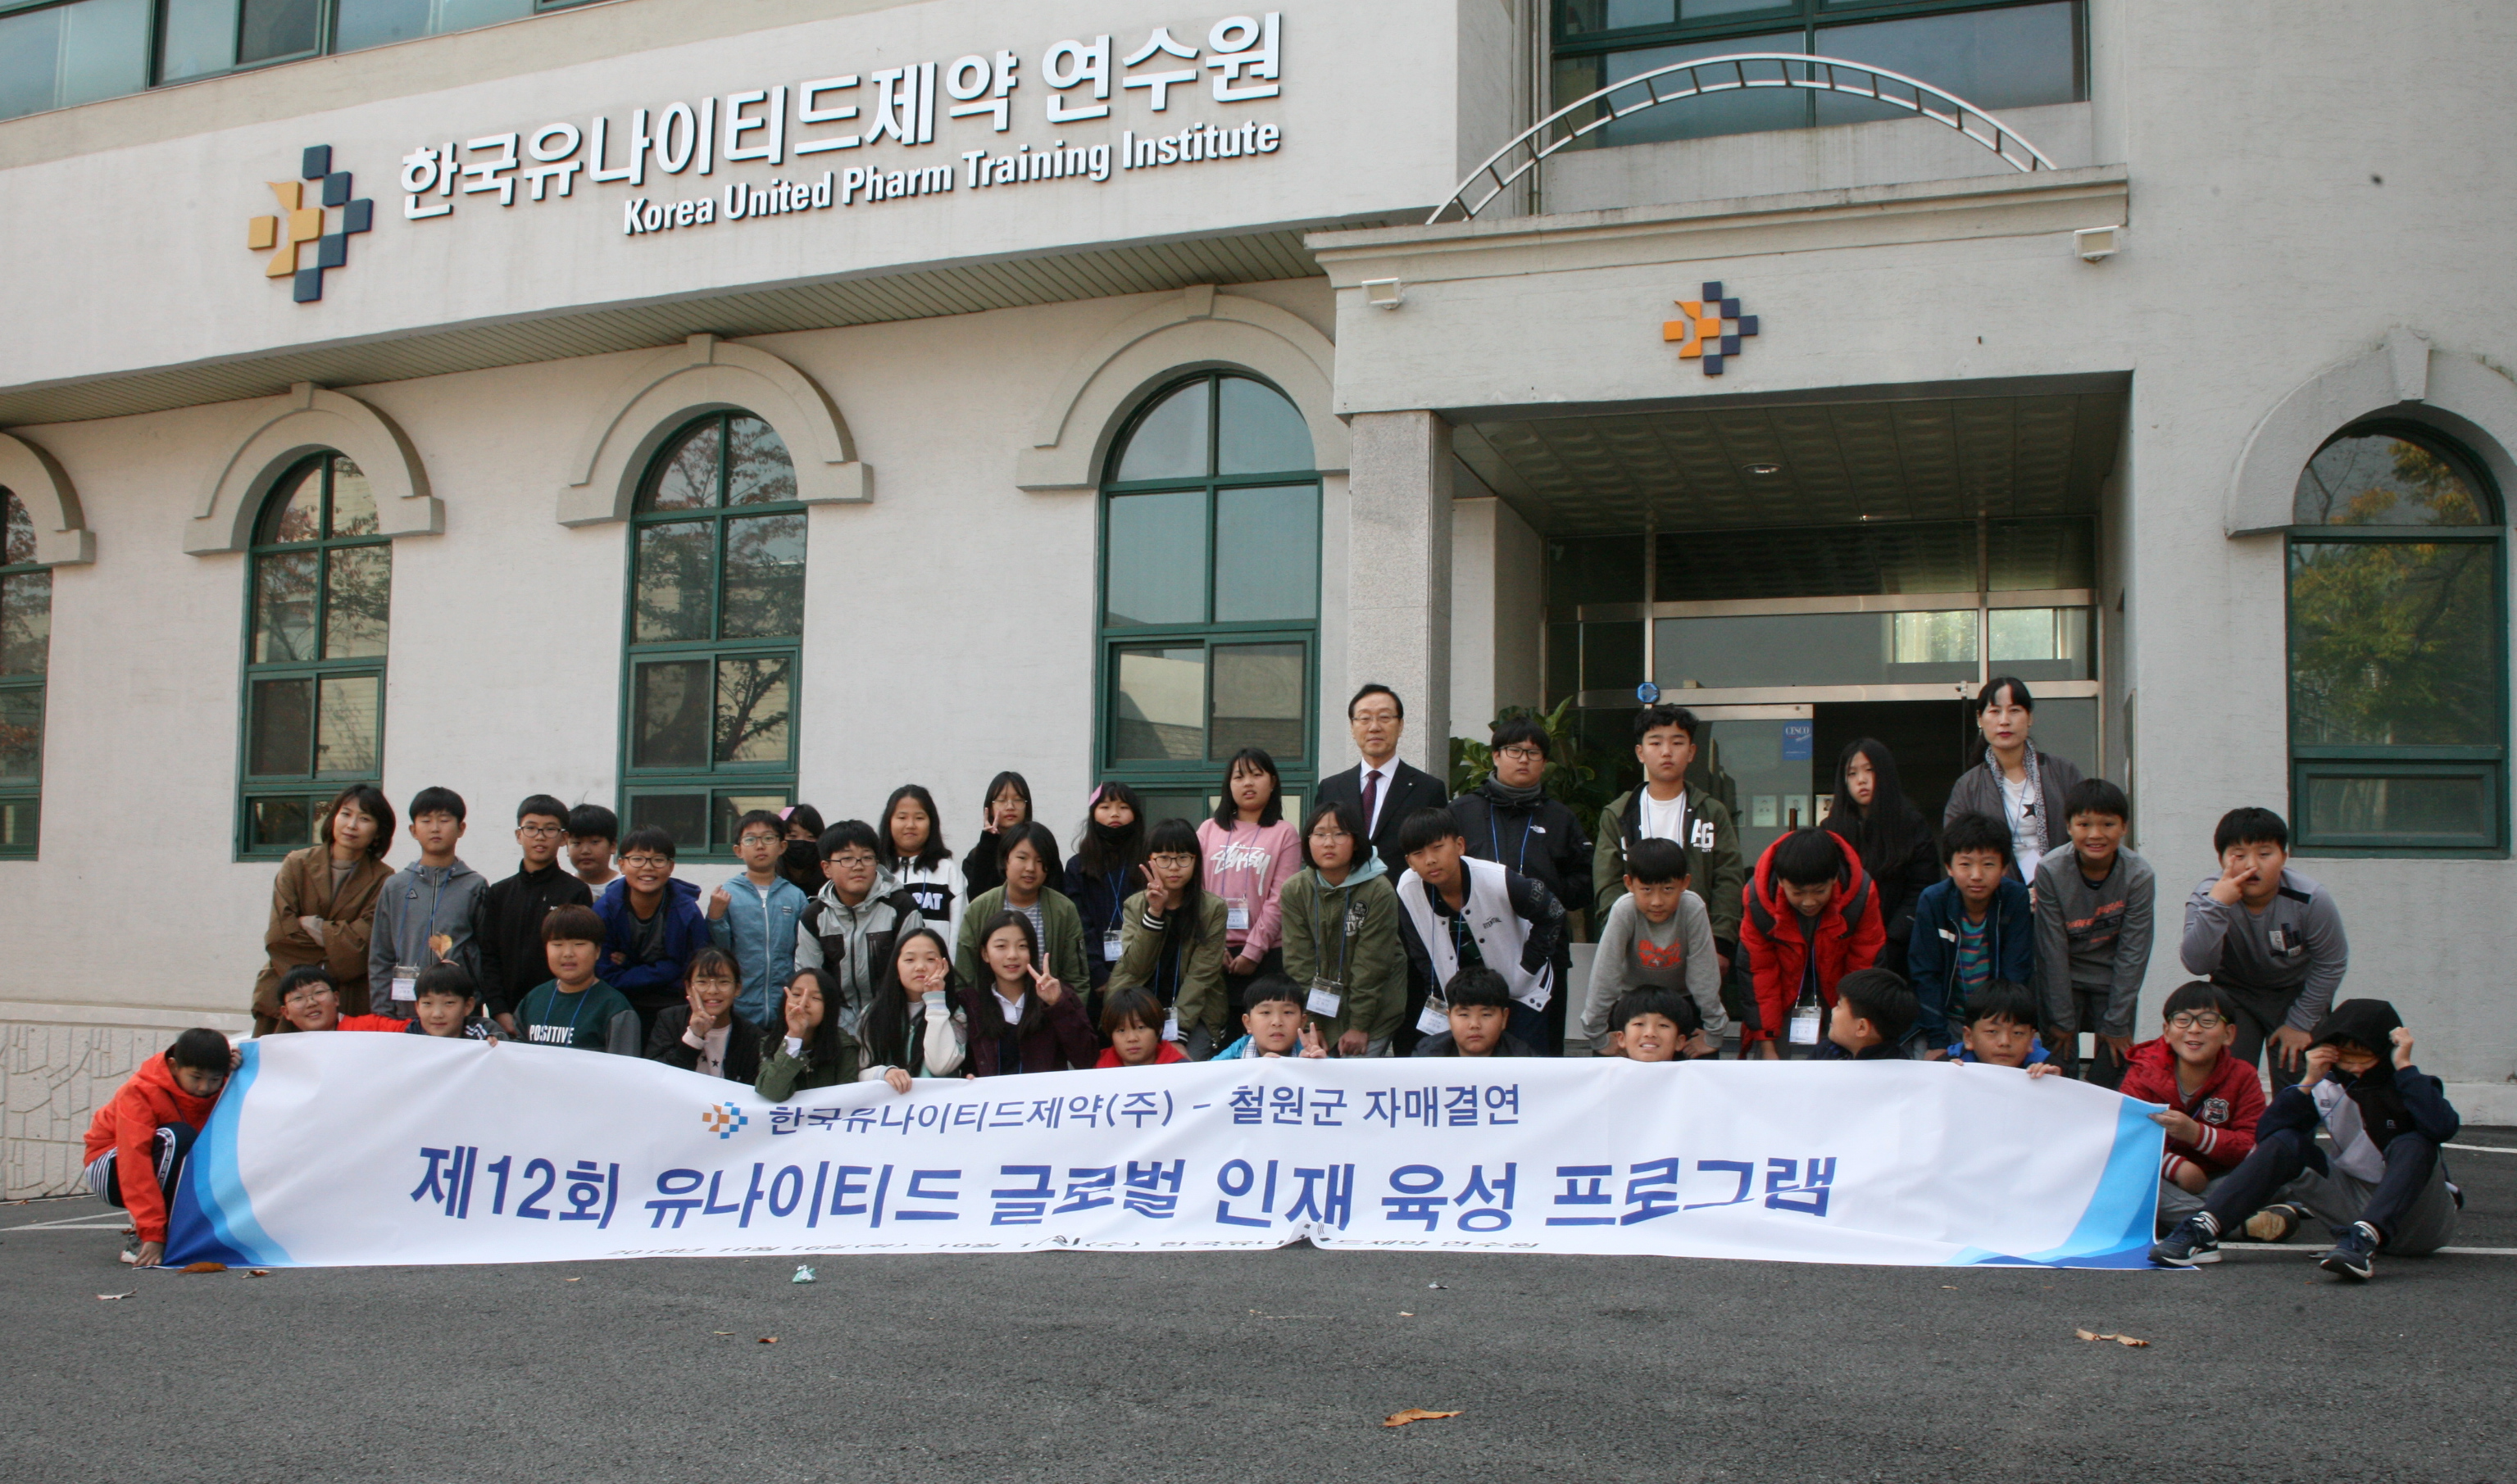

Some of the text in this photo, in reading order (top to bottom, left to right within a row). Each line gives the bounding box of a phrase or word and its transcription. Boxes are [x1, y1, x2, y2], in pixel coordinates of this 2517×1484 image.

[400, 11, 1280, 220] 한국유나이티드제약 연수원
[624, 120, 1280, 234] Korea United Pharm Training Institute
[529, 1024, 575, 1044] POSITIVE
[769, 1088, 1174, 1136] 한국유나이티드제약(주)
[1229, 1085, 1347, 1127] 철원군
[1363, 1083, 1520, 1128] 자매결연
[411, 1146, 1838, 1232] 제12회 유나이티드 글로벌 인재 육성 프로그램
